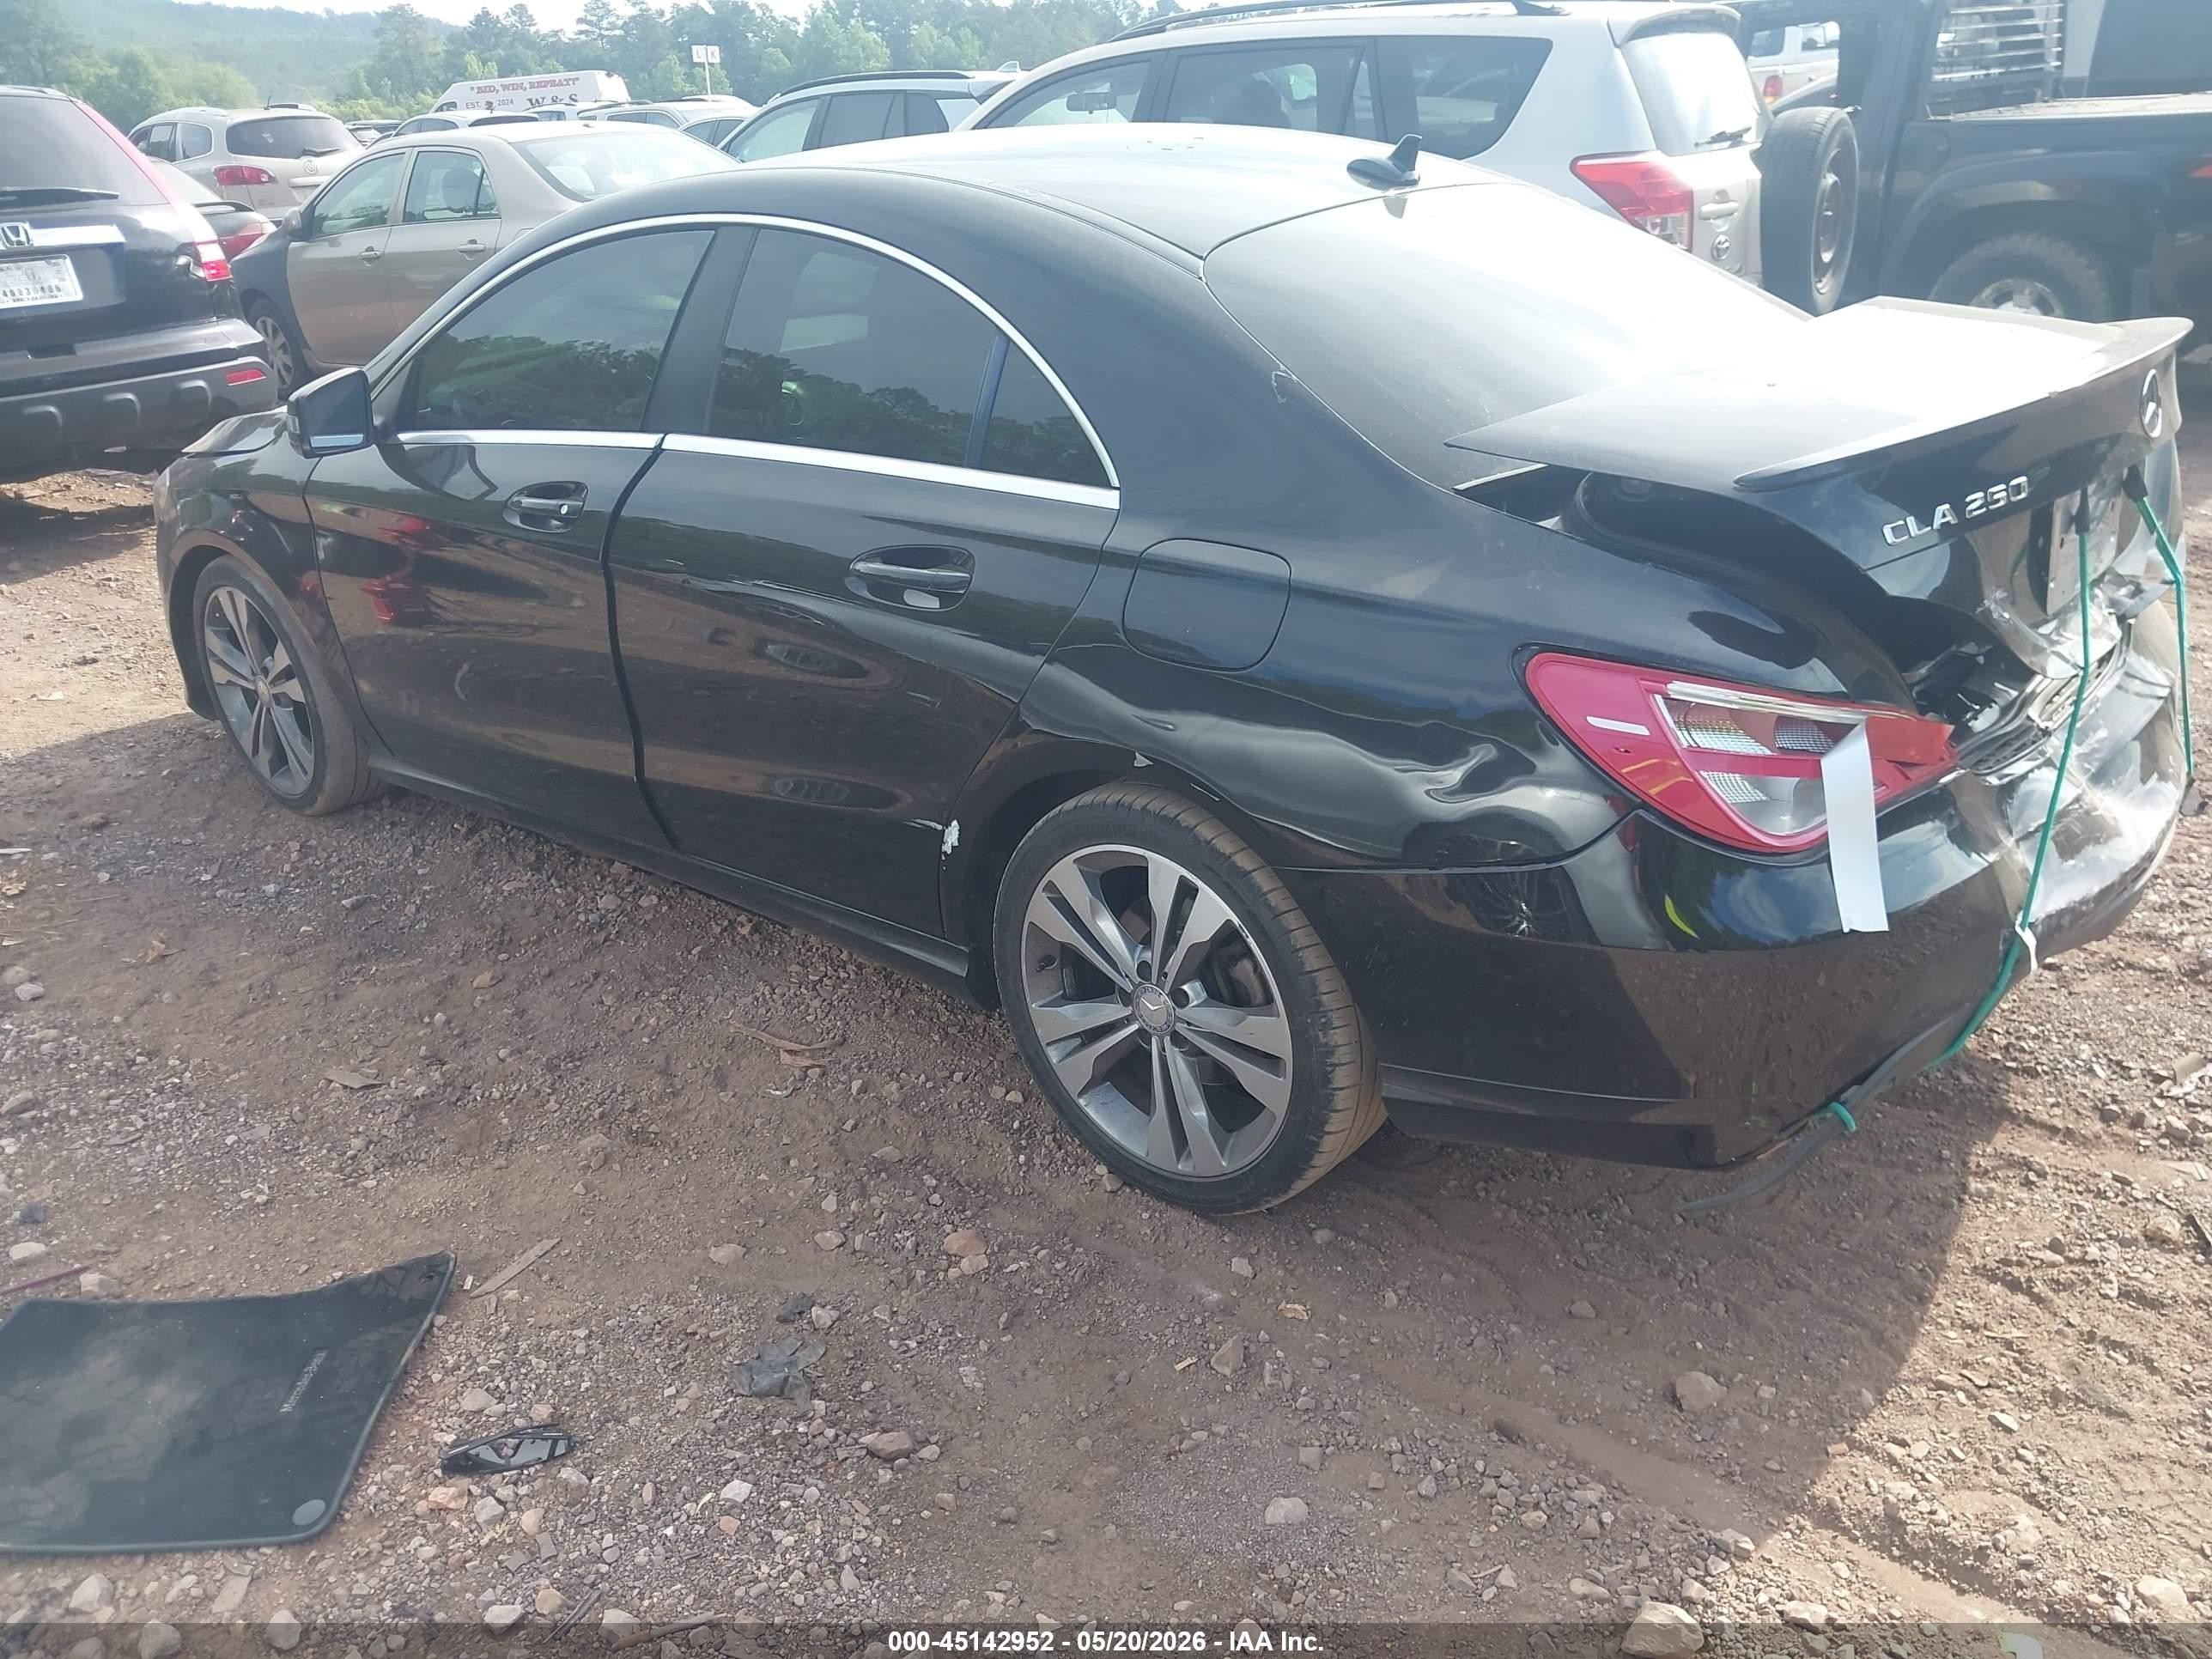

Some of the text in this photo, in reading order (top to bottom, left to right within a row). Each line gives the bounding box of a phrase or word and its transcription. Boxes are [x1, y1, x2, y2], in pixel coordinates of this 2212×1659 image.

[500, 82, 527, 92] WIN,
[496, 98, 514, 106] 2024
[1882, 476, 2029, 546] CLA 250
